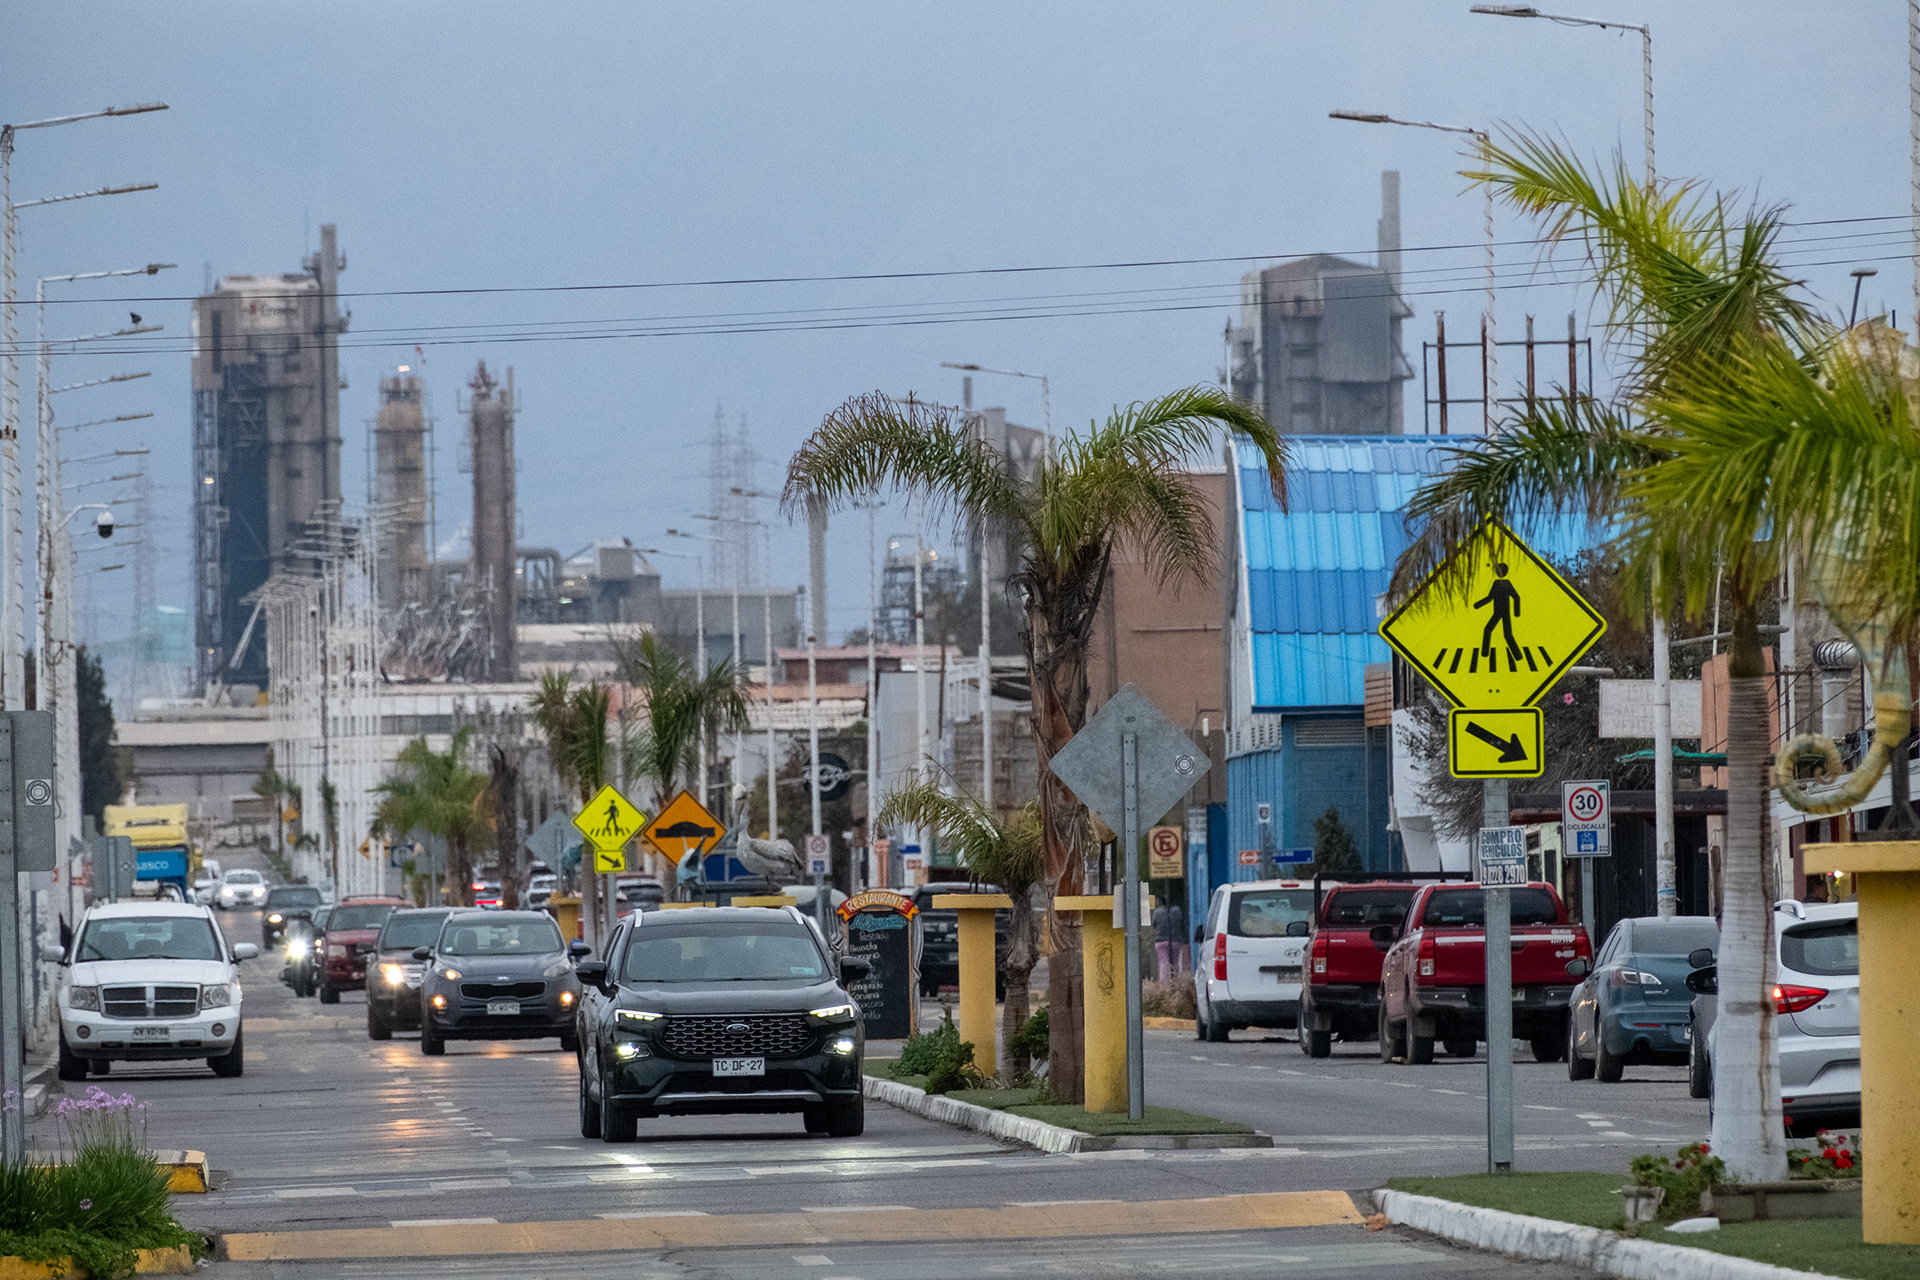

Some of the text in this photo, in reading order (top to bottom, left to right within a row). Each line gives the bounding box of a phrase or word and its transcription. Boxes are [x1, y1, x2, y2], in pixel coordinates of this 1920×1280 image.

[1575, 794, 1597, 810] 30
[1481, 830, 1522, 844] COMPRO
[845, 892, 910, 912] RESTAURANTE
